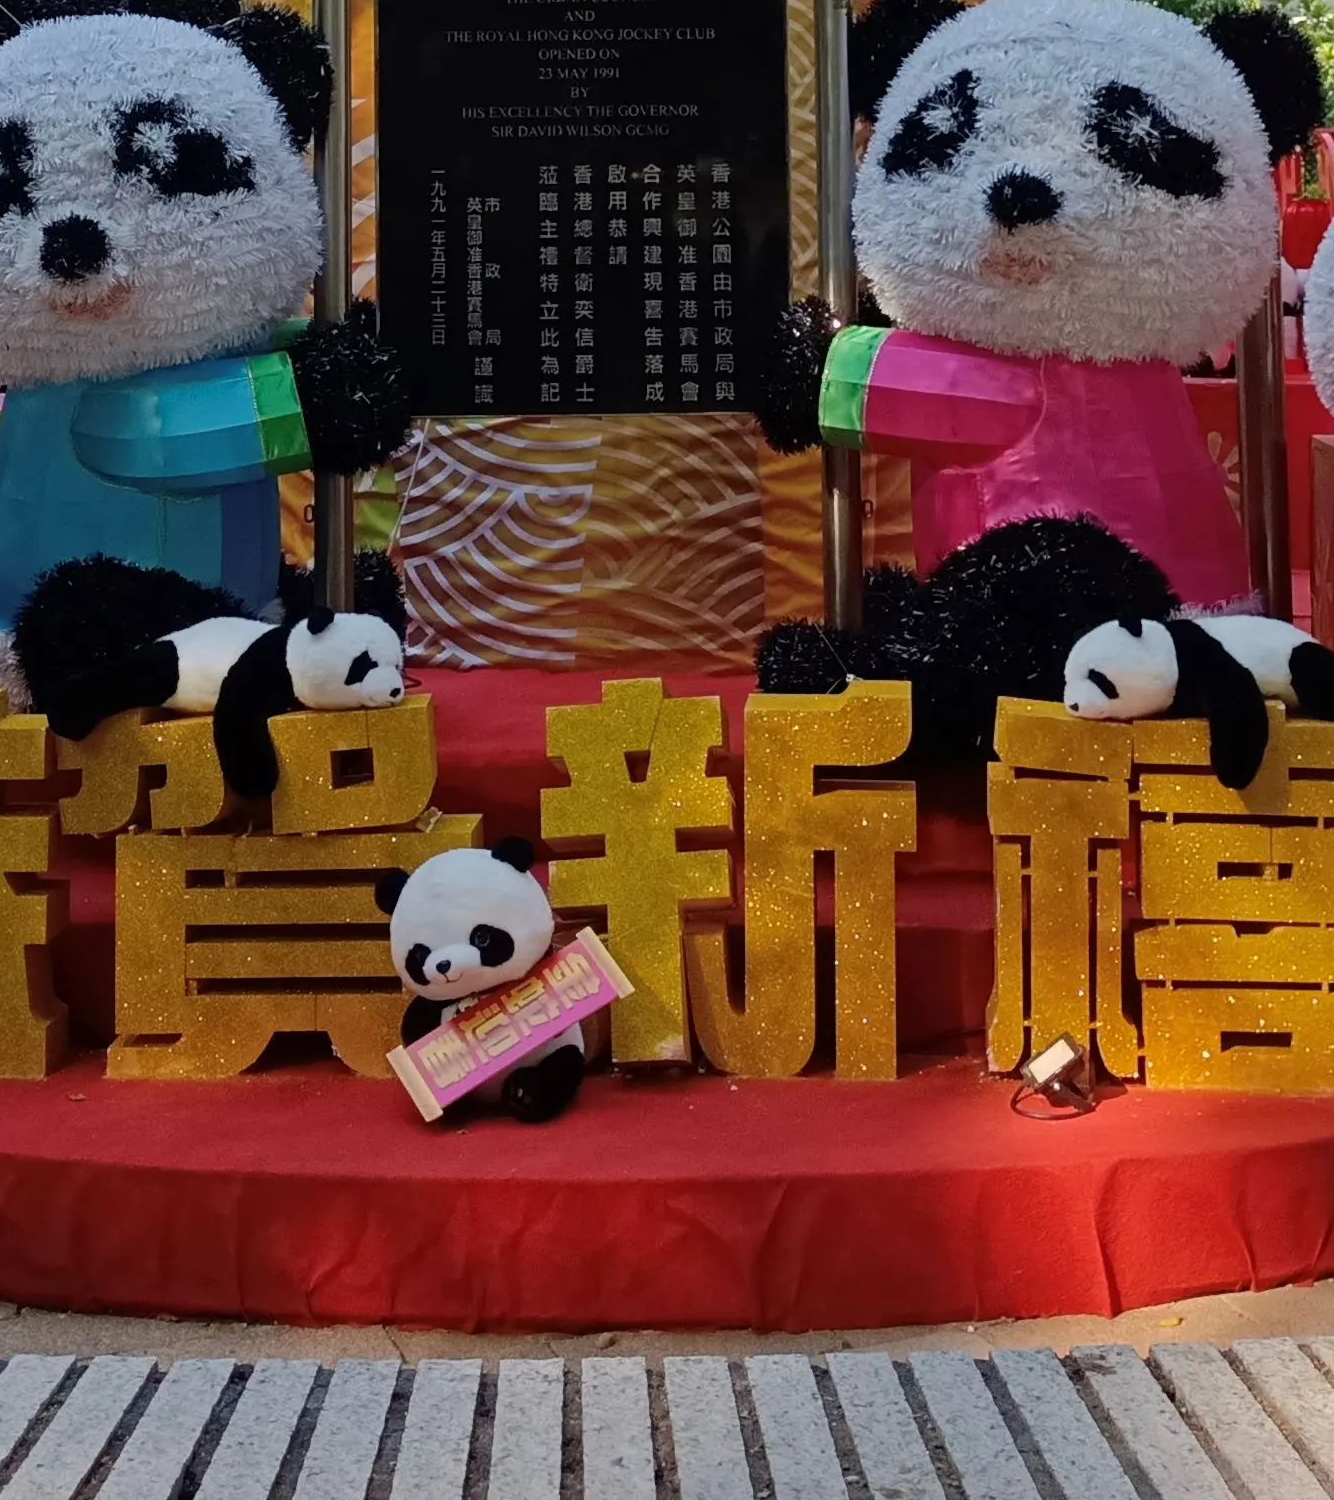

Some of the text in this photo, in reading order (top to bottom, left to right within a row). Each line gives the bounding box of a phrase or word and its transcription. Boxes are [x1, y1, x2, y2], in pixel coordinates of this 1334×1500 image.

[564, 10, 595, 22] AND
[446, 27, 716, 43] THE ROYAL HONG KONG JOCKEY CLUB
[538, 48, 620, 61] OPENED ON
[538, 67, 620, 80] 23 MAY 1991
[570, 87, 590, 99] BY
[462, 104, 700, 119] HIS EXCELLENCY THE GOVERNOR
[491, 124, 670, 138] SIR DAVID WILSON GCMG
[607, 164, 628, 266] 啟用恭請
[430, 168, 447, 346] 一九九一年五月二十三日
[573, 164, 595, 402] 香港總督衛奕信爵士
[642, 164, 665, 402] 合作興建現喜告落成
[677, 164, 700, 401] 英皇御准香港賽馬會
[711, 163, 735, 401] 香港公園由市政局與
